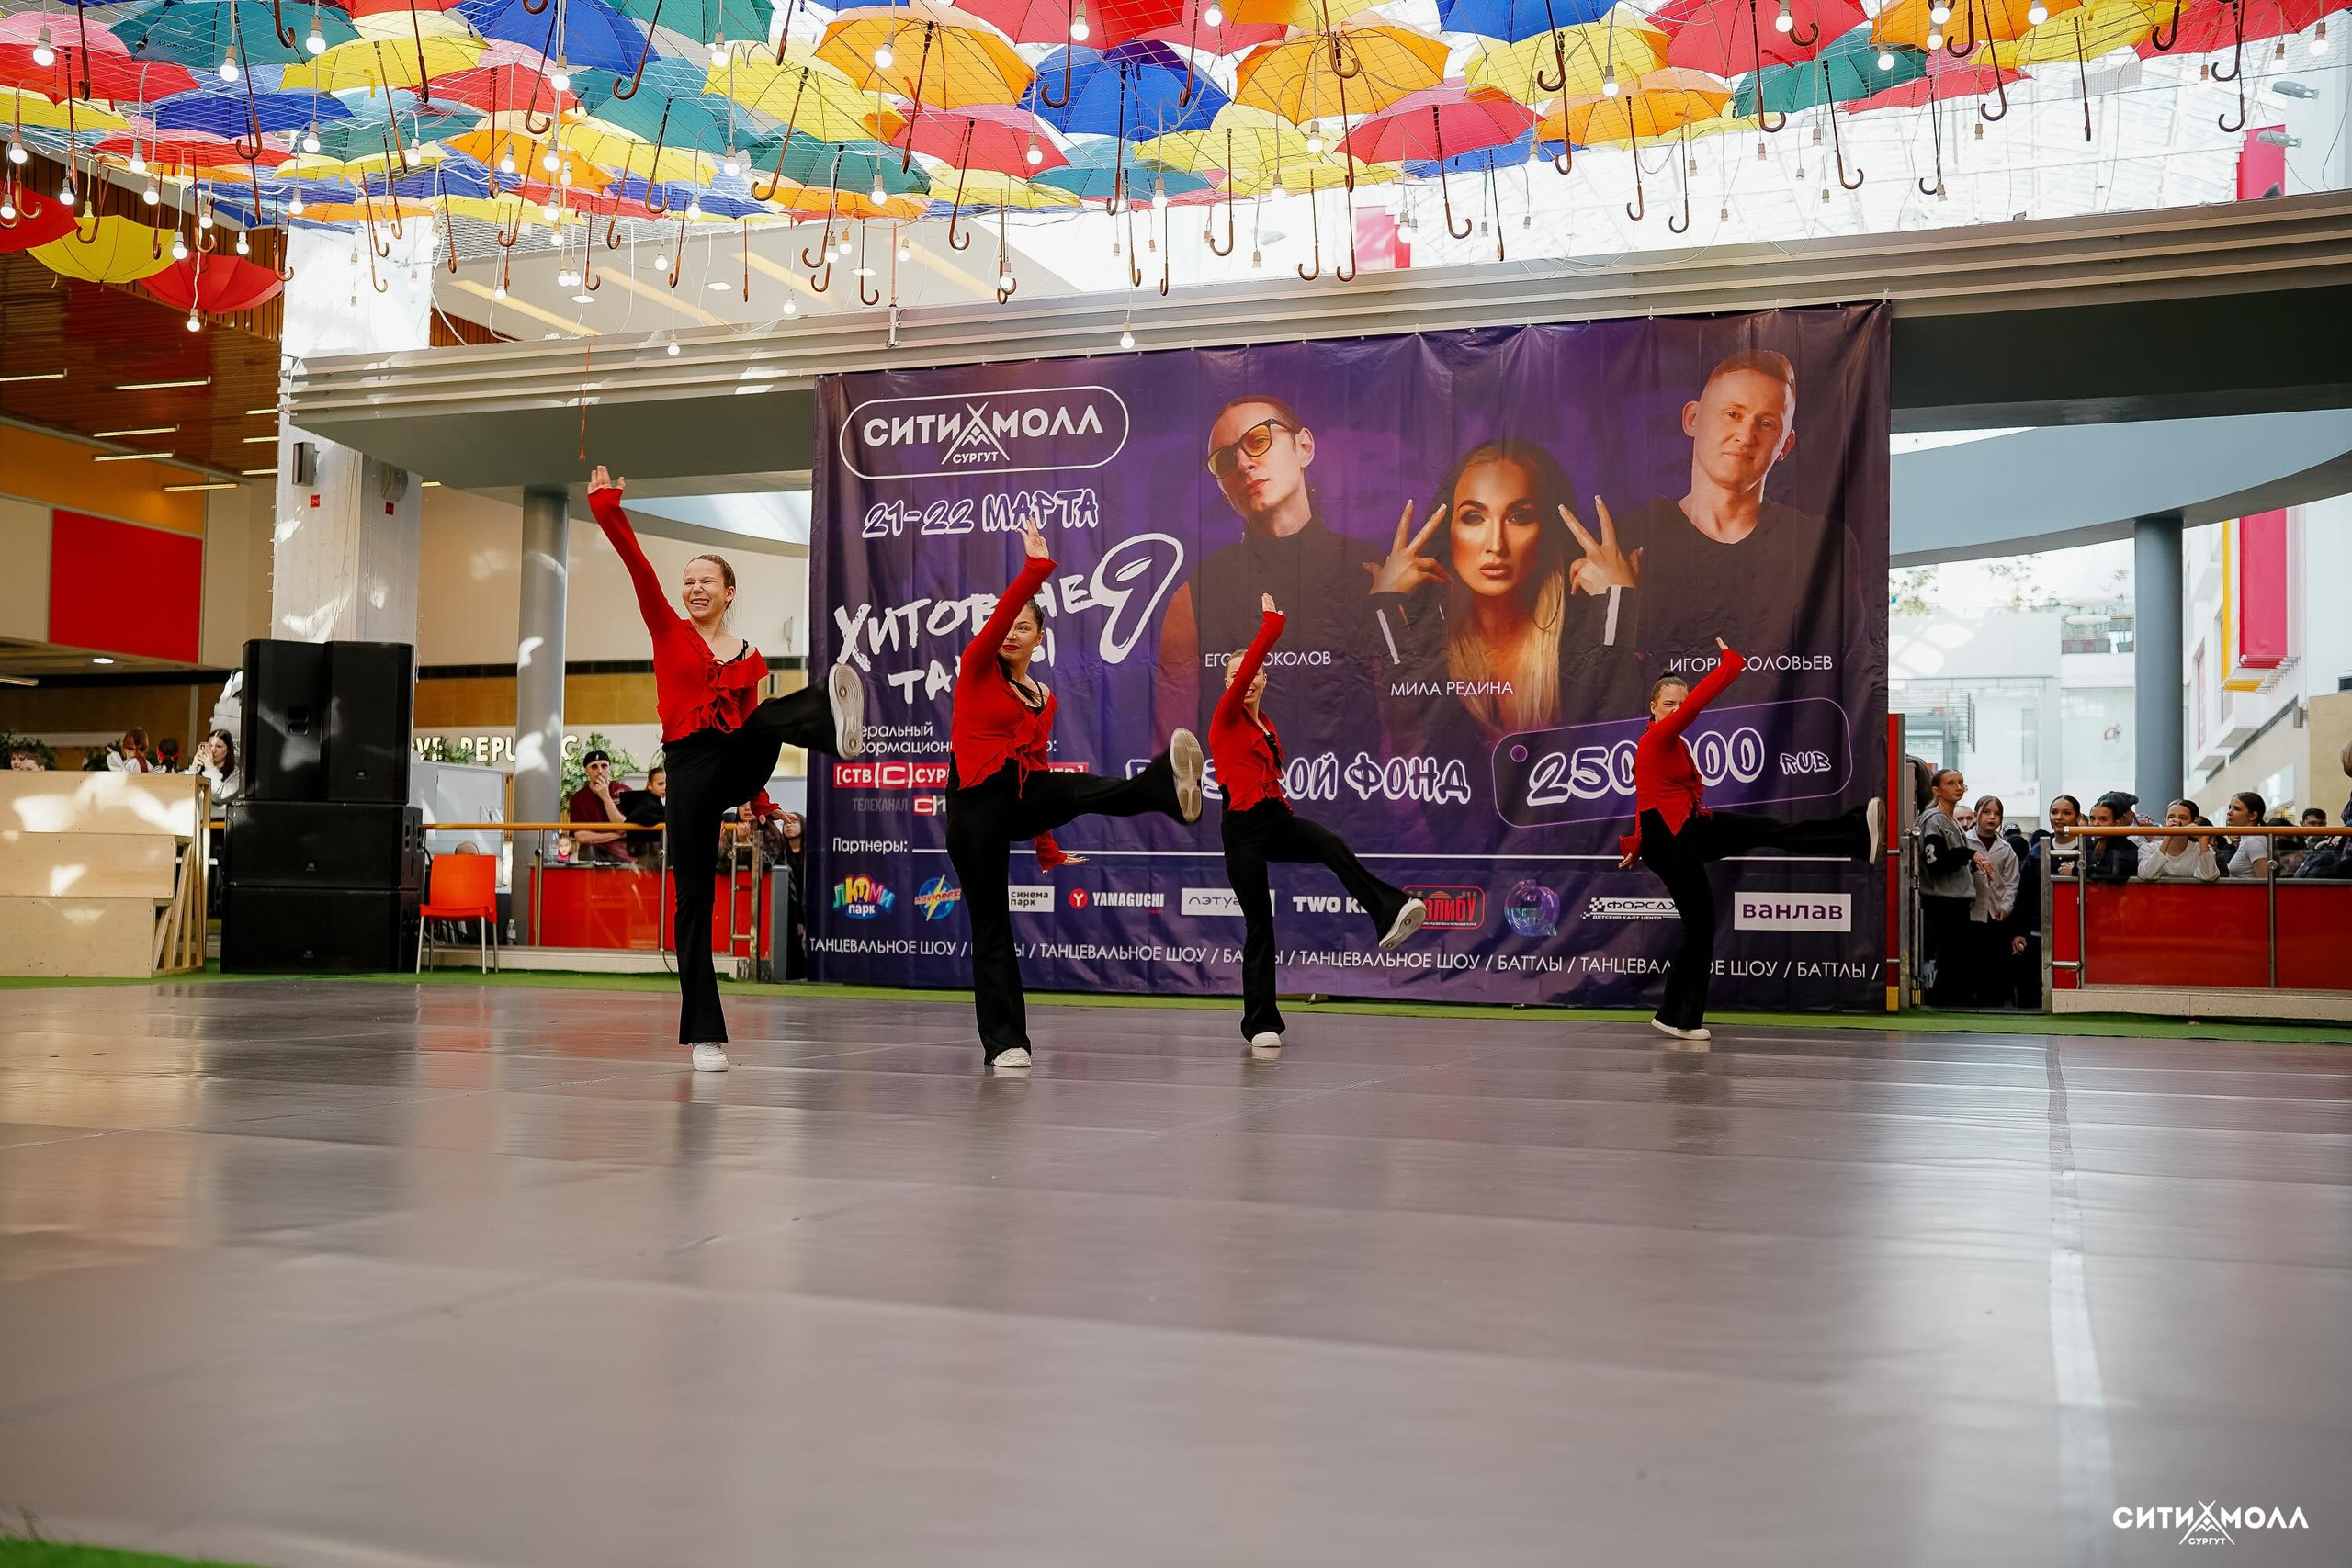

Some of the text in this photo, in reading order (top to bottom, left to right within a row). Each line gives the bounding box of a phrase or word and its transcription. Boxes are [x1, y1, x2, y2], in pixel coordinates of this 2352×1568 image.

[953, 451, 999, 464] СУРГУТ
[862, 488, 1099, 538] 21-22 МАРТА
[1263, 651, 1331, 666] ОКОЛОВ
[1670, 655, 1833, 672] ИГОР ОЛОВЬЕВ
[1390, 681, 1513, 697] МИЛА РЕДИНА
[1679, 727, 1765, 787] 00
[1780, 751, 1831, 775] RUB
[1344, 751, 1470, 805] ФОНД
[852, 797, 909, 812] ТЕЛЕКАНАЛ
[833, 837, 908, 855] Партнеры:
[1010, 891, 1048, 899] синема
[1093, 892, 1164, 908] YAMAGUCHI
[848, 903, 876, 916] парк
[1010, 899, 1036, 908] парк
[1293, 896, 1340, 913] TWO
[1743, 903, 1843, 919] ванлав
[809, 938, 917, 954] ТАНЦЕВАЛЬНОЕ
[920, 940, 957, 956] ШОУ
[1040, 943, 1161, 961] ТАНЦЕВАЛЬНОЕ
[1166, 947, 1207, 962] ШОУ
[1300, 951, 1432, 968] ТАНЦЕВАЛЬНОЕ
[1437, 953, 1480, 970] ШОУ
[1498, 955, 1563, 972] БАТТЛЫ
[1731, 960, 1778, 977] ШОУ
[1797, 962, 1866, 978] БАТТЛЫ
